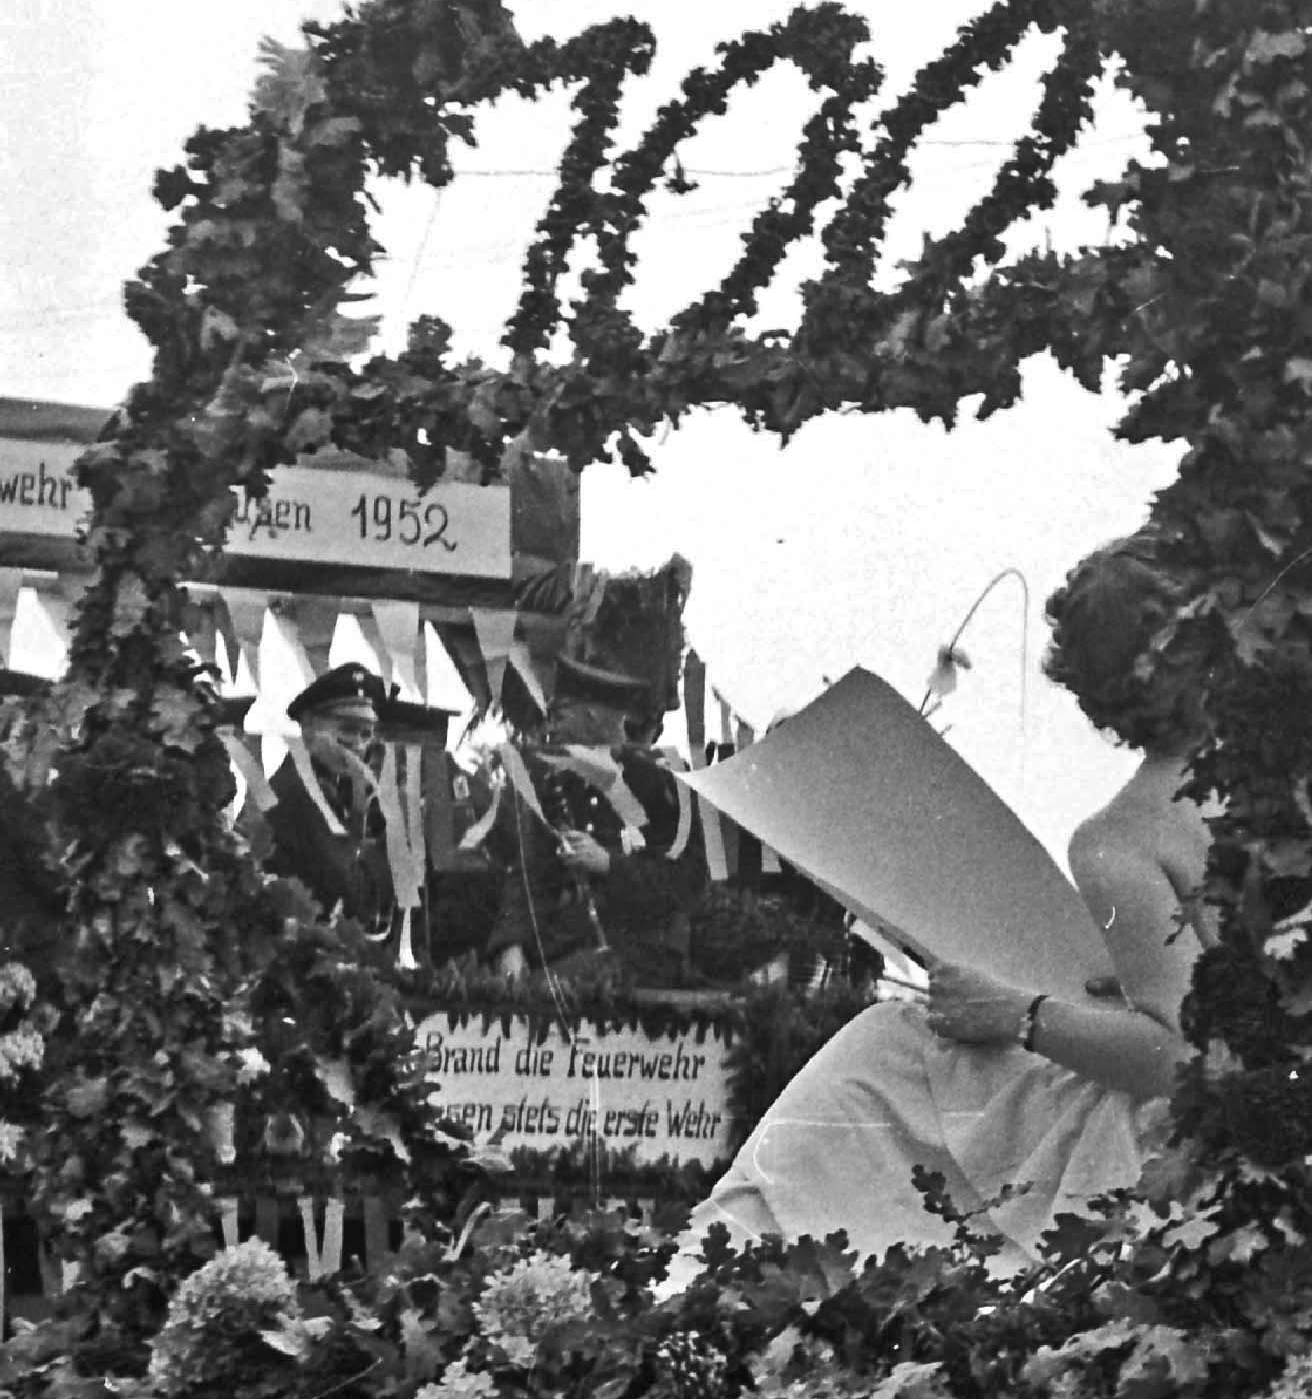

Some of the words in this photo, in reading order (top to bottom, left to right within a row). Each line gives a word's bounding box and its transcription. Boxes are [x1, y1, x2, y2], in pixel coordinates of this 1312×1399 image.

[351, 493, 457, 552] 1952
[426, 1031, 500, 1074] Brand
[514, 1035, 554, 1077] die
[567, 1037, 706, 1080] Feuerwehr
[501, 1097, 560, 1133] stets
[565, 1099, 598, 1137] die
[604, 1100, 659, 1137] erste
[666, 1099, 722, 1138] Wehr
